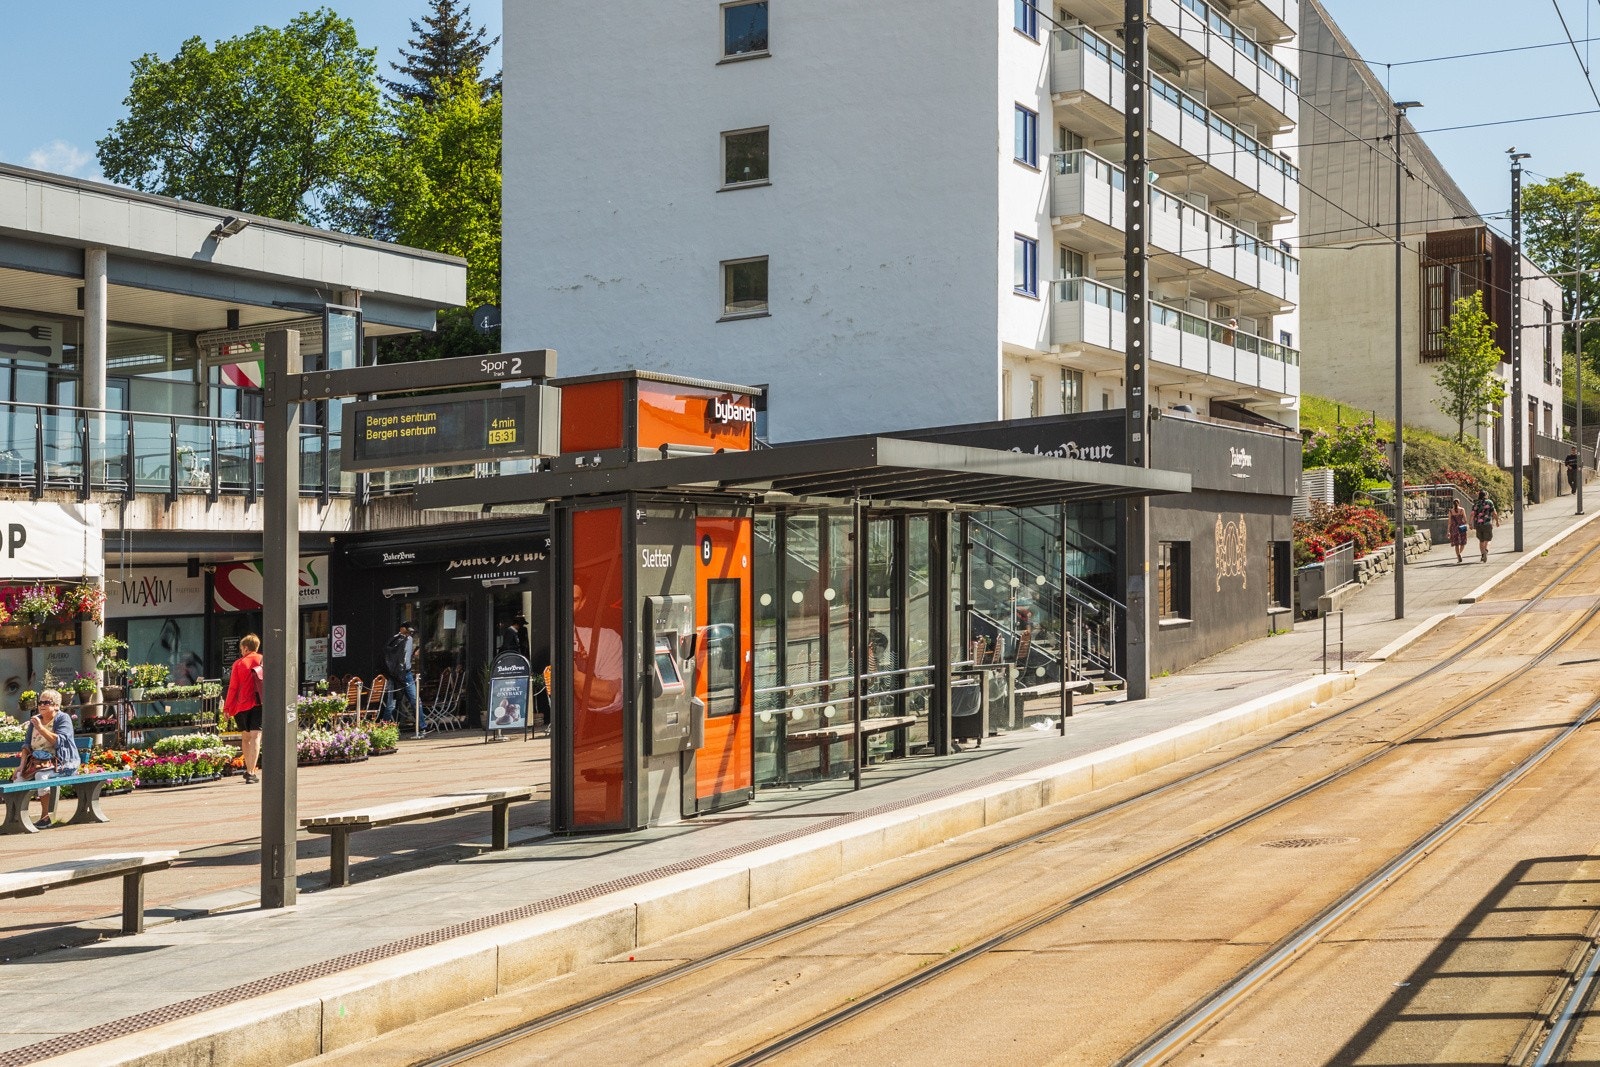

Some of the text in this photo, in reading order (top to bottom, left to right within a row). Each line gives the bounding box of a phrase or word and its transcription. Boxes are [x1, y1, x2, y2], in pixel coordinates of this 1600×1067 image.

[480, 357, 522, 375] Spor 2
[366, 411, 437, 427] Bergen sentrum
[715, 396, 756, 424] bybanen
[491, 417, 515, 428] 4 min
[366, 425, 436, 441] Bergen sentrum
[489, 430, 516, 443] 15:31
[0, 523, 27, 559] P
[704, 540, 711, 559] B
[642, 548, 672, 568] Sletten
[121, 575, 173, 607] MAXIM
[298, 588, 320, 597] etten
